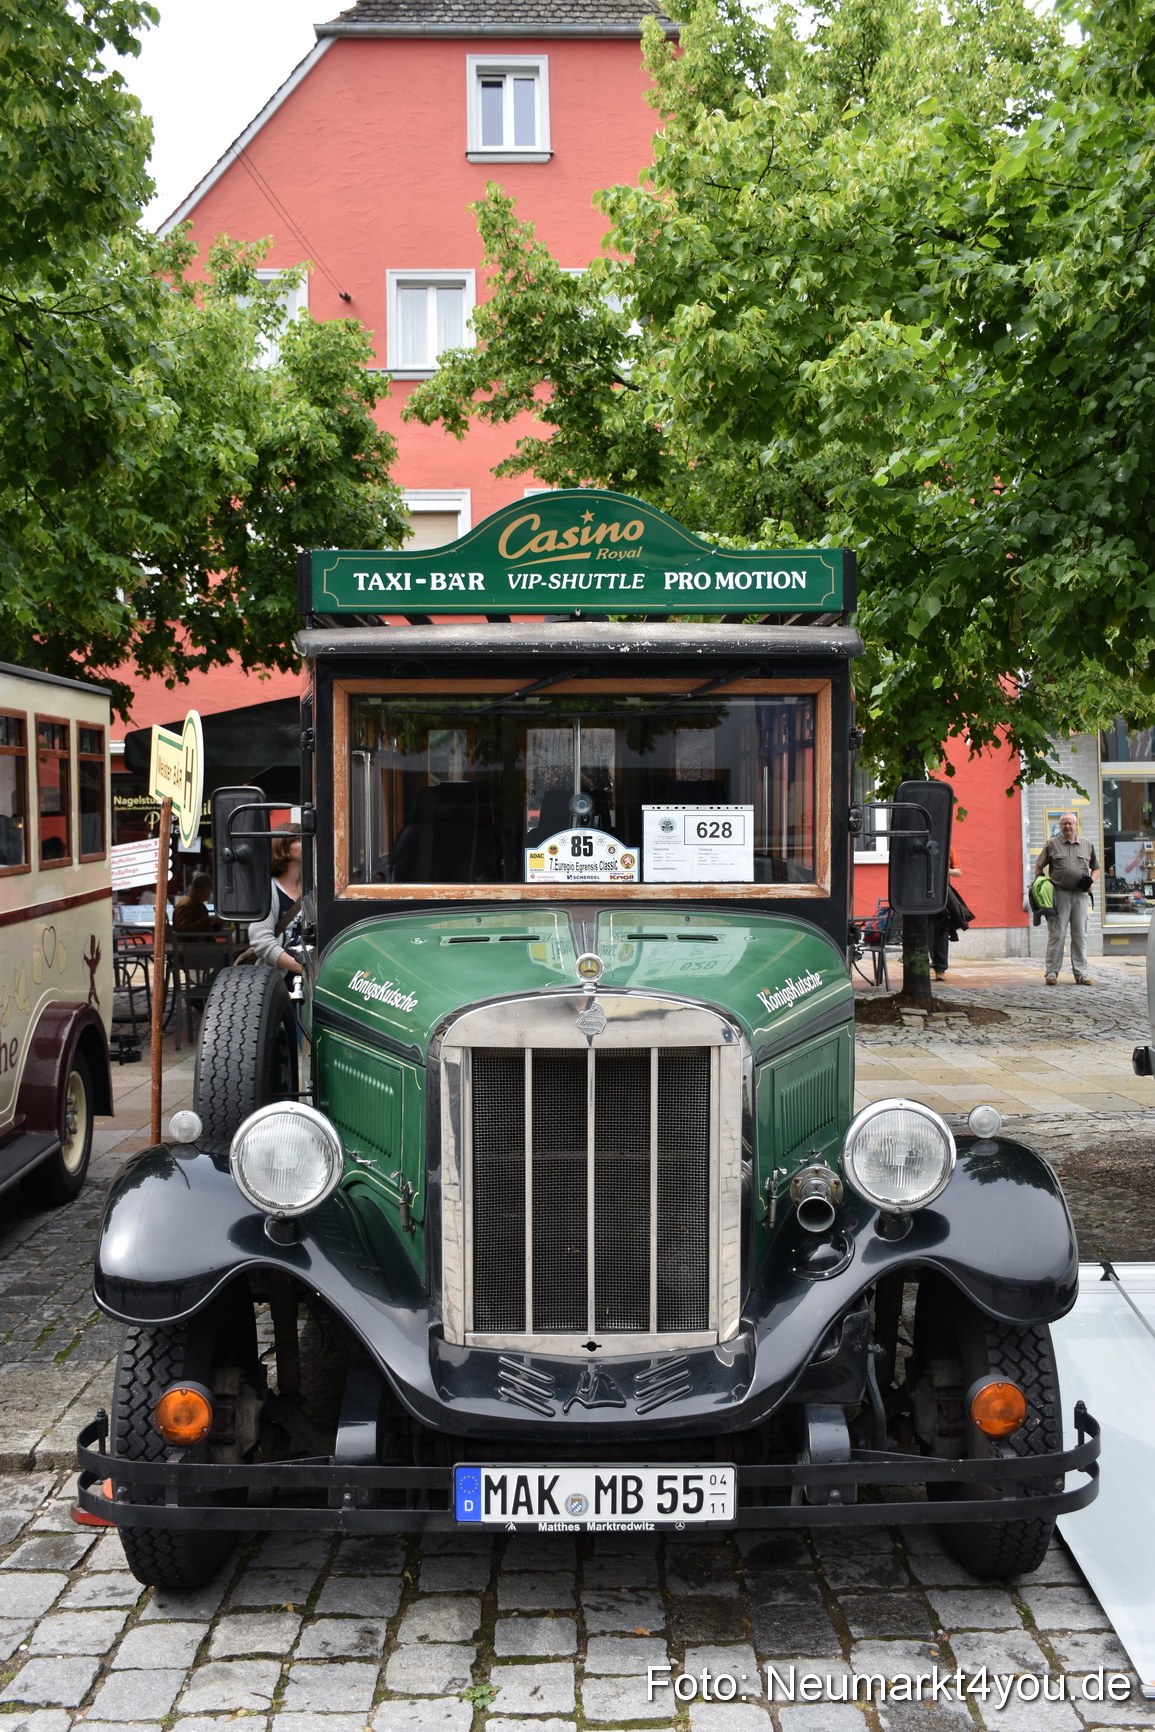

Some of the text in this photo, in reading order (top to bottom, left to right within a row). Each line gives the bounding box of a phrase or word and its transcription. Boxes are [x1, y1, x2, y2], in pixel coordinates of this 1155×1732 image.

[498, 510, 645, 559] Casino
[595, 546, 643, 562] Royal
[507, 573, 645, 590] VIP-SHUTTLE
[696, 821, 733, 839] 628
[570, 835, 594, 857] 85
[599, 857, 618, 871] Classic
[464, 1500, 474, 1512] D
[484, 1474, 561, 1515] MAK
[594, 1474, 643, 1515] MB
[656, 1474, 704, 1515] 55
[709, 1474, 727, 1486] 04
[709, 1502, 726, 1514] 11
[538, 1522, 655, 1532] Matthes Marktredwitz
